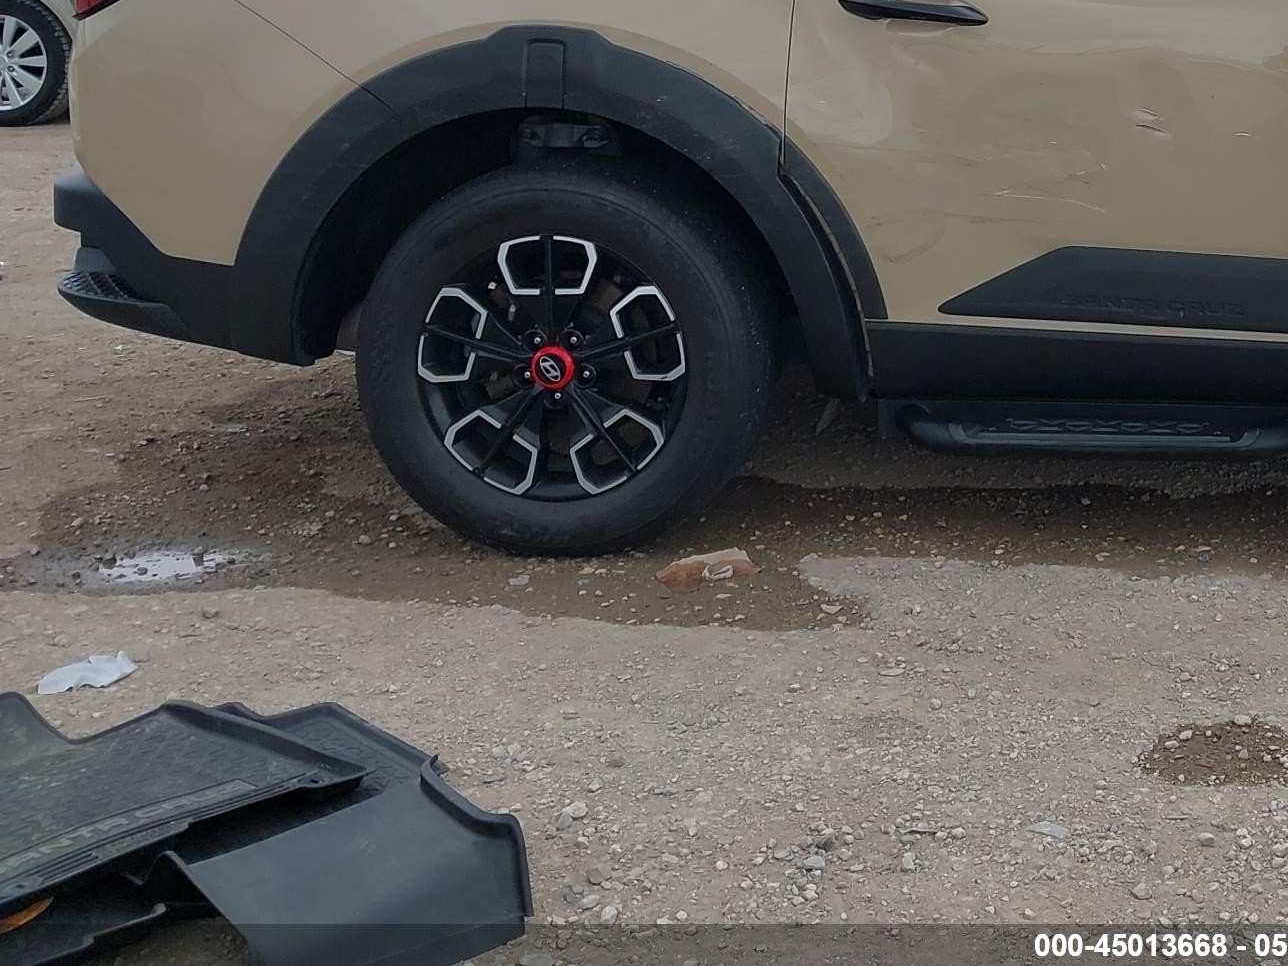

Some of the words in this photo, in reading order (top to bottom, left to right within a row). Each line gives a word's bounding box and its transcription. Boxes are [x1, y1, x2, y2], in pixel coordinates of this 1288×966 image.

[1061, 293, 1159, 313] SANTA
[1168, 299, 1245, 317] CRUZ
[134, 783, 240, 818] CRUZ
